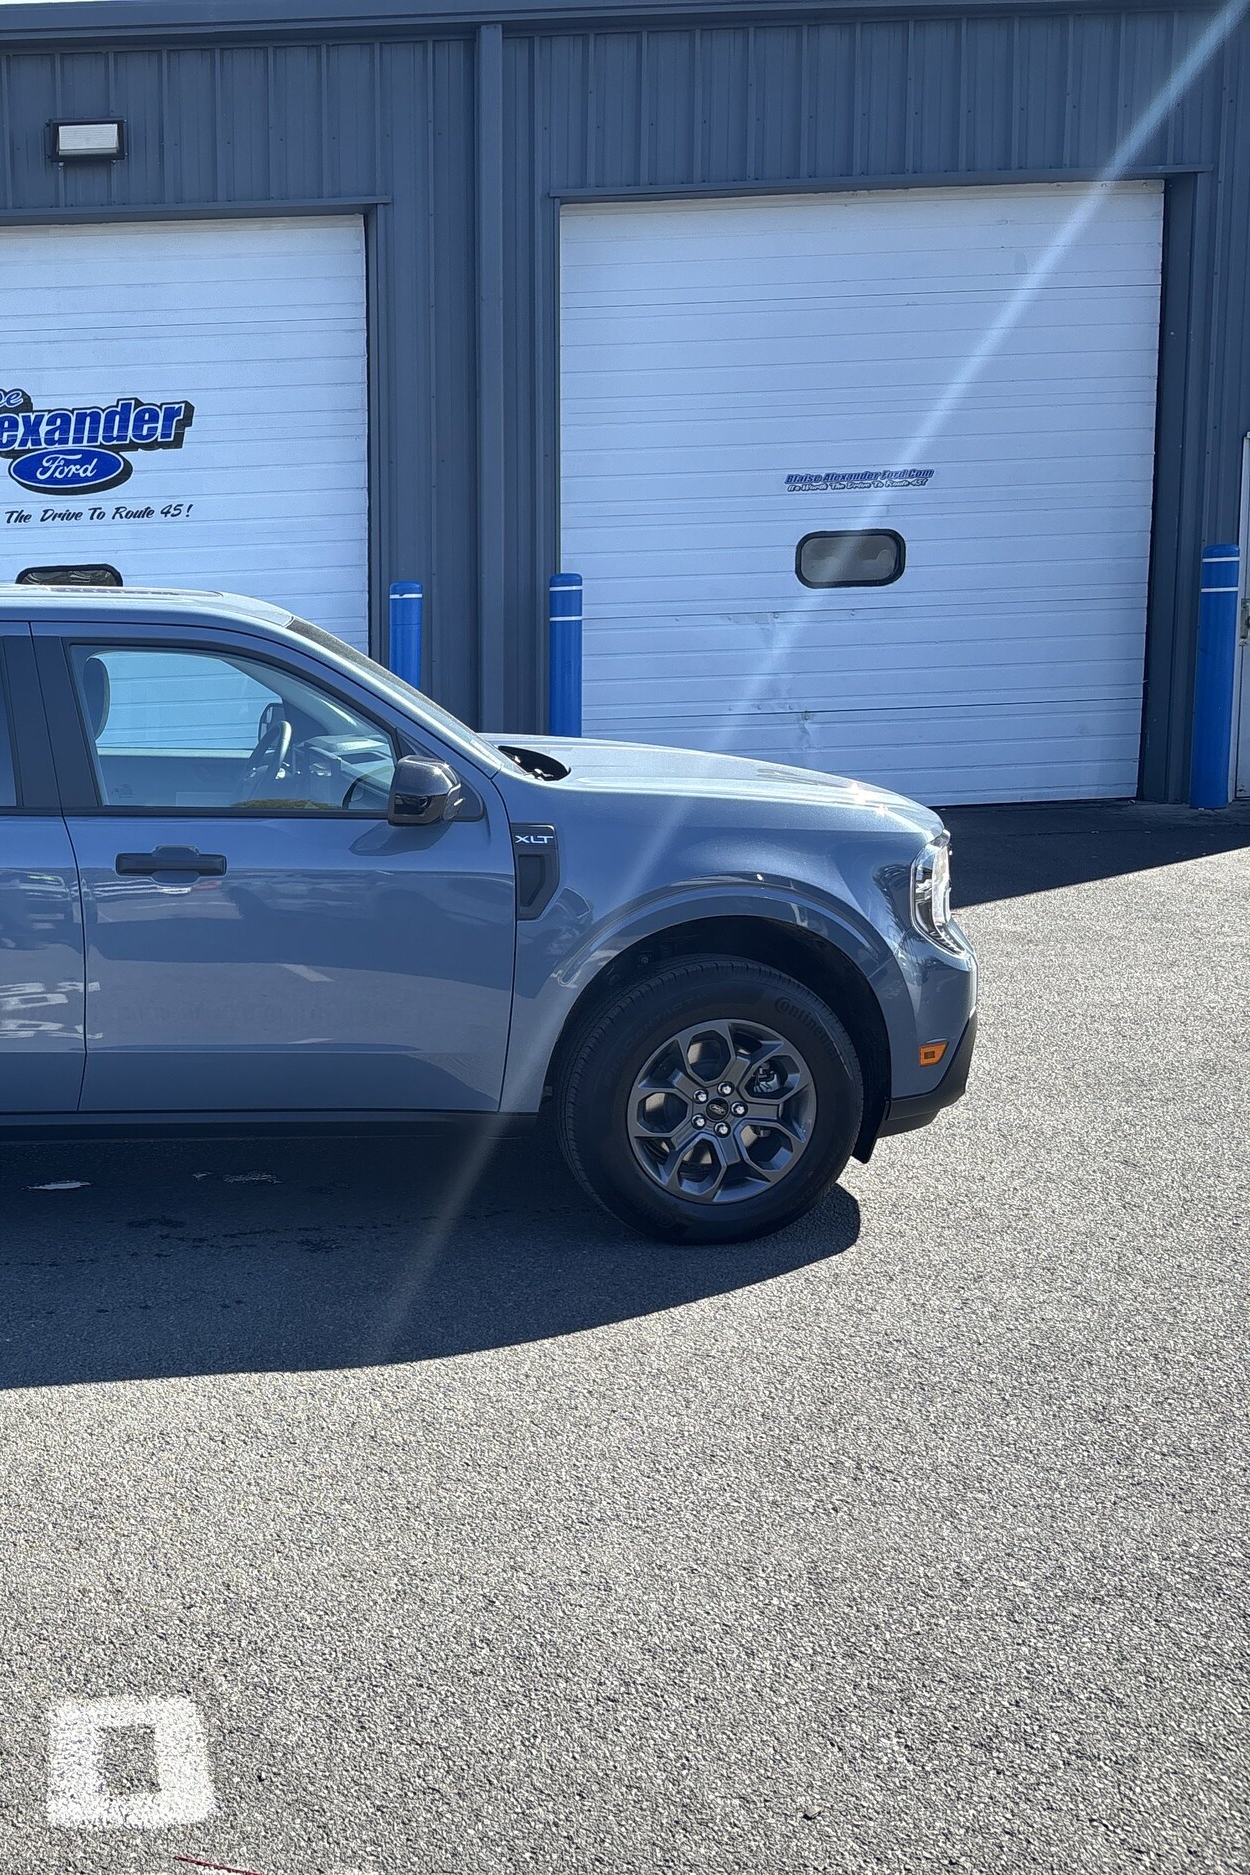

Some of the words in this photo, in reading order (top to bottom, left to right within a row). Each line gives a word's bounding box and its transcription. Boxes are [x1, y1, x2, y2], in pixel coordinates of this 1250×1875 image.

[35, 452, 98, 481] Ford
[784, 473, 822, 484] Blaise
[822, 472, 882, 482] Alexander
[4, 508, 32, 524] The
[39, 507, 84, 523] Drive
[87, 506, 106, 521] To
[111, 504, 155, 520] Route
[514, 835, 554, 844] XLT
